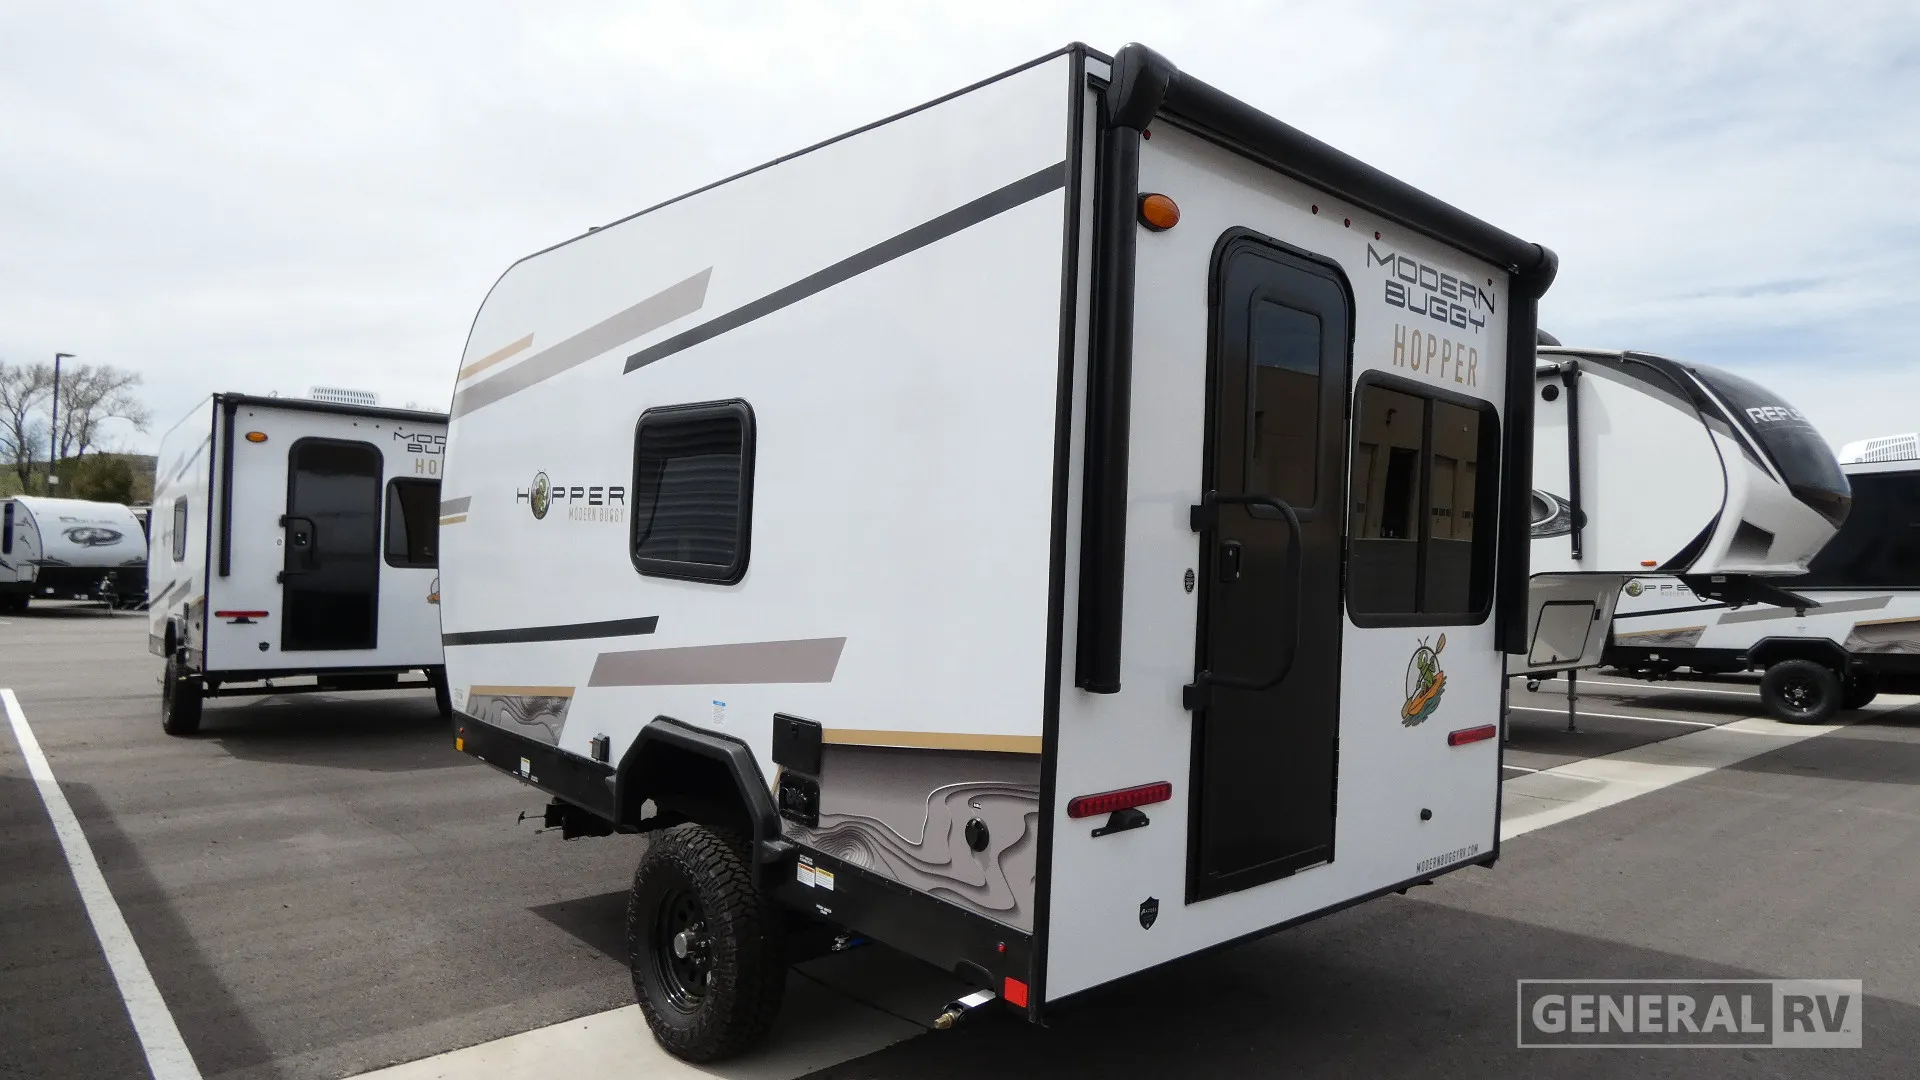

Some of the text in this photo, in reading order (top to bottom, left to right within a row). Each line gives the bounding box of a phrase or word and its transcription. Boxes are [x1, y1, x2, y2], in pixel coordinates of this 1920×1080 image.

[1367, 242, 1495, 315] MODERN
[1385, 279, 1485, 334] BUGGY
[1393, 323, 1478, 388] HOPPER
[407, 443, 446, 455] BU
[415, 457, 437, 475] HO
[568, 507, 625, 523] MODERN BUGGY
